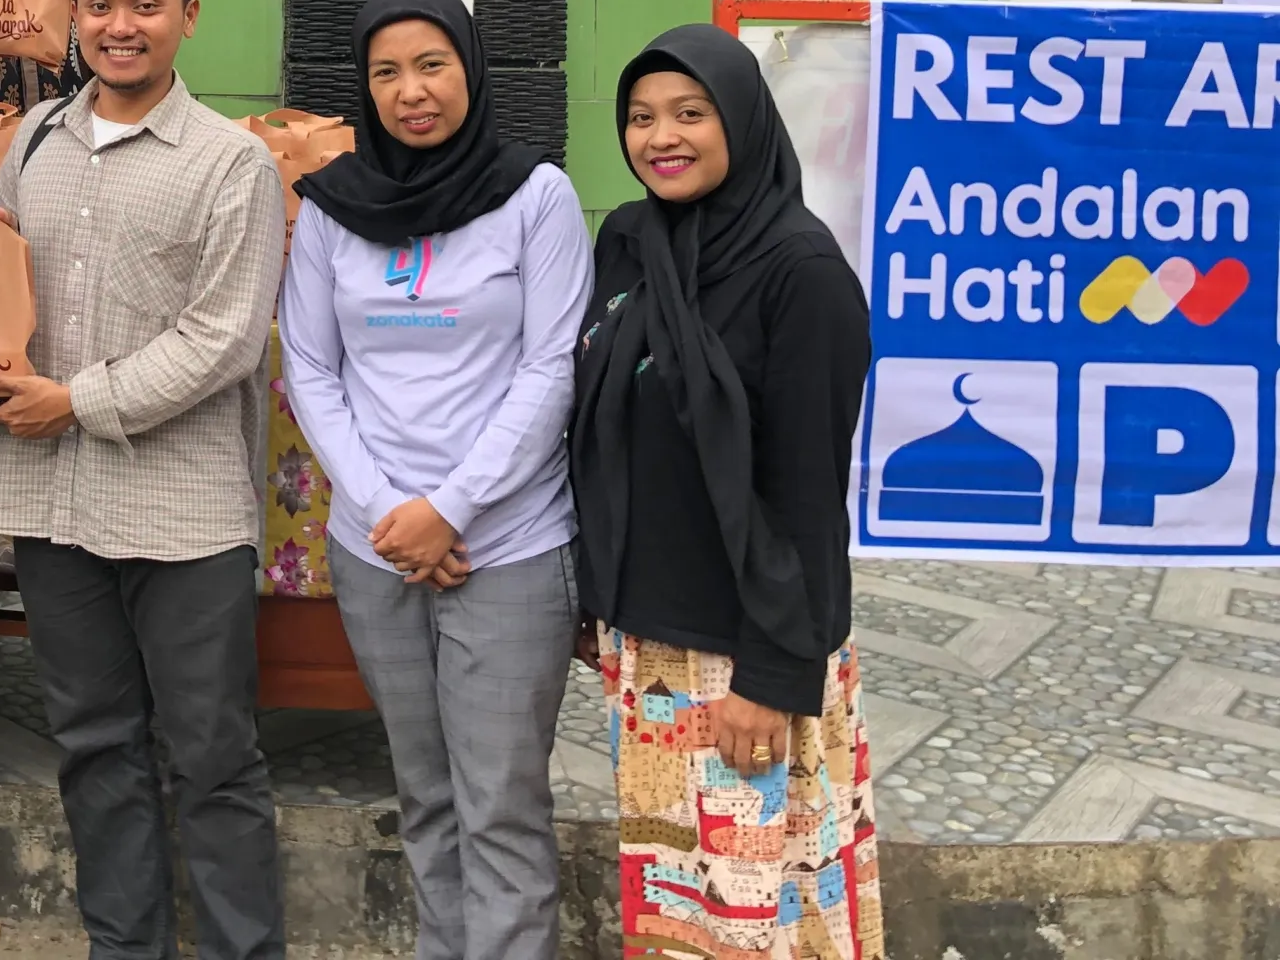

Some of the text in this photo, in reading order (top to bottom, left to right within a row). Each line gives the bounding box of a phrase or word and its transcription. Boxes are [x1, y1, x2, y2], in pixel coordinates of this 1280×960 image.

[892, 33, 1146, 125] REST
[885, 166, 1250, 242] Andalan
[887, 252, 1066, 323] Hati
